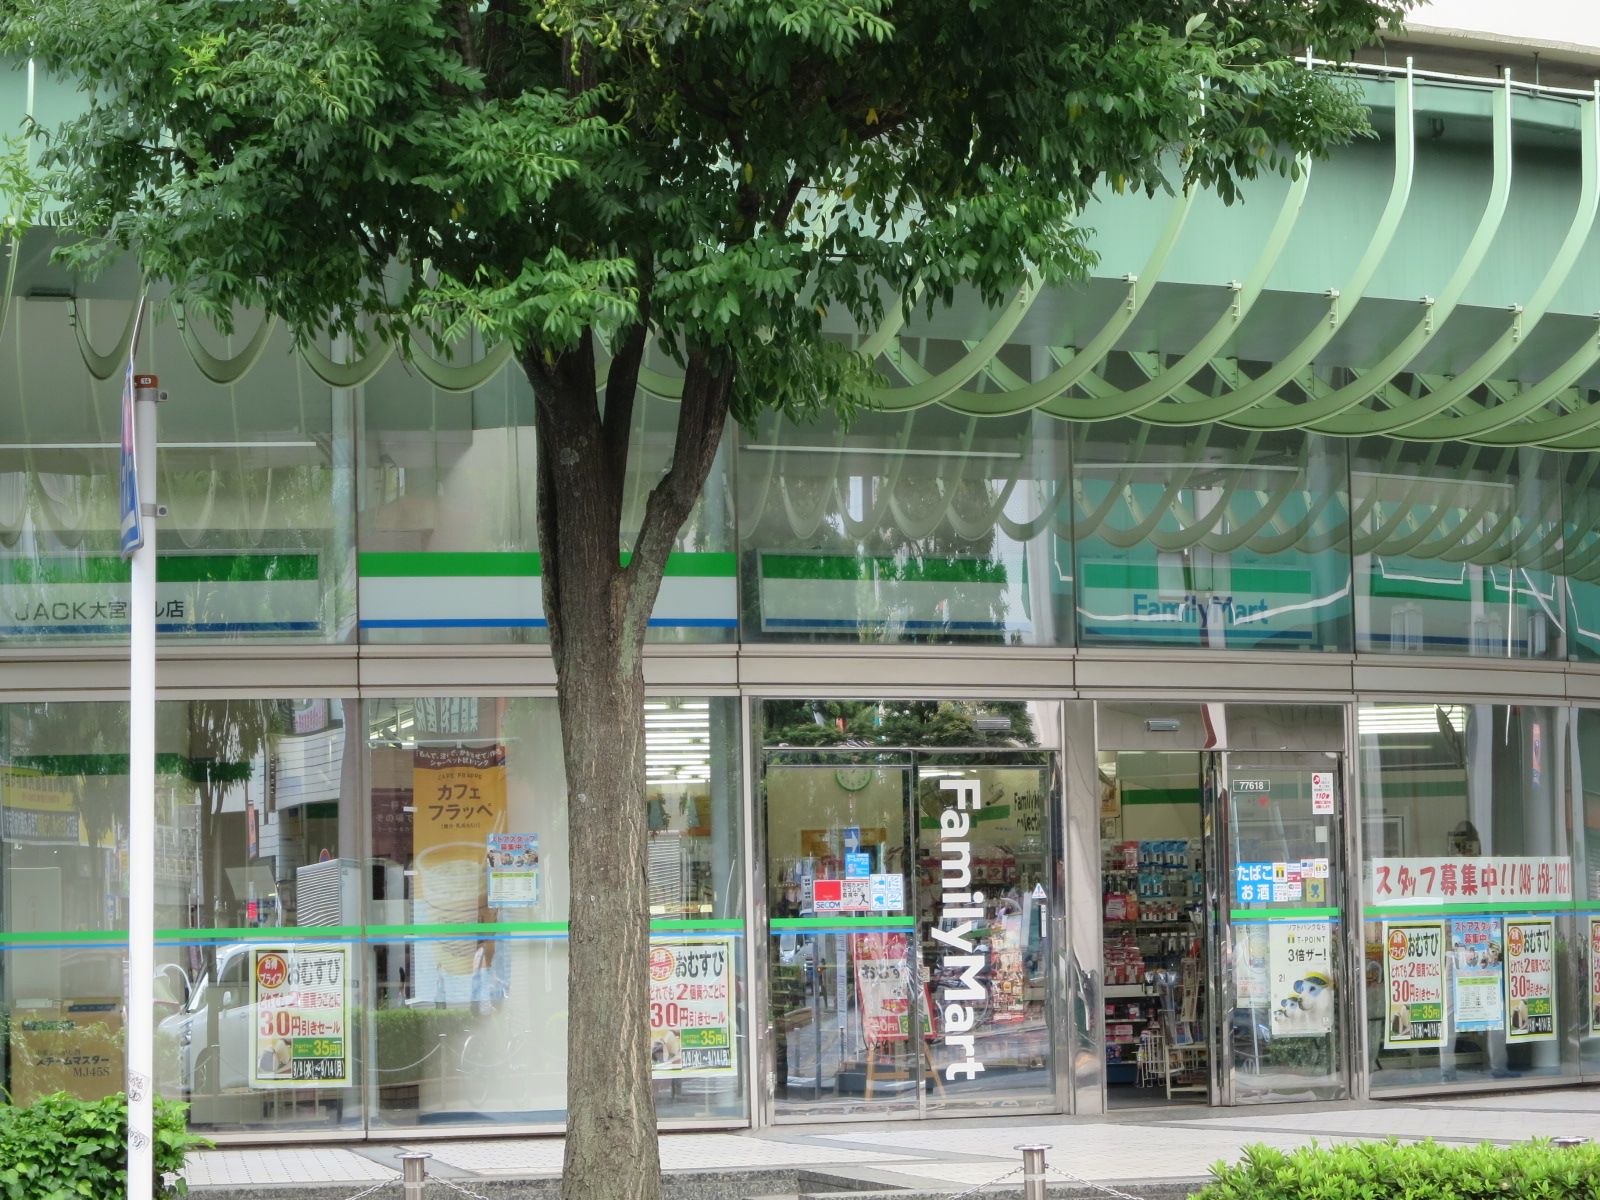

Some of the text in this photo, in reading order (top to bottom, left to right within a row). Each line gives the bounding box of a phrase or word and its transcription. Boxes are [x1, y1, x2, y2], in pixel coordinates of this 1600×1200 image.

[15, 600, 184, 621] JACK大宮ル店
[438, 784, 481, 801] カフェ
[1240, 782, 1264, 790] 77618
[428, 803, 494, 821] フラッペ
[1237, 865, 1272, 881] たばこ
[1241, 884, 1270, 900] お酒
[816, 901, 841, 909] SECOM
[931, 779, 986, 1081] FamilyMart
[1408, 932, 1439, 957] おむすび
[1523, 929, 1550, 953] おむすび
[675, 950, 725, 977] おむすび
[650, 1003, 726, 1028] 30円引きセール
